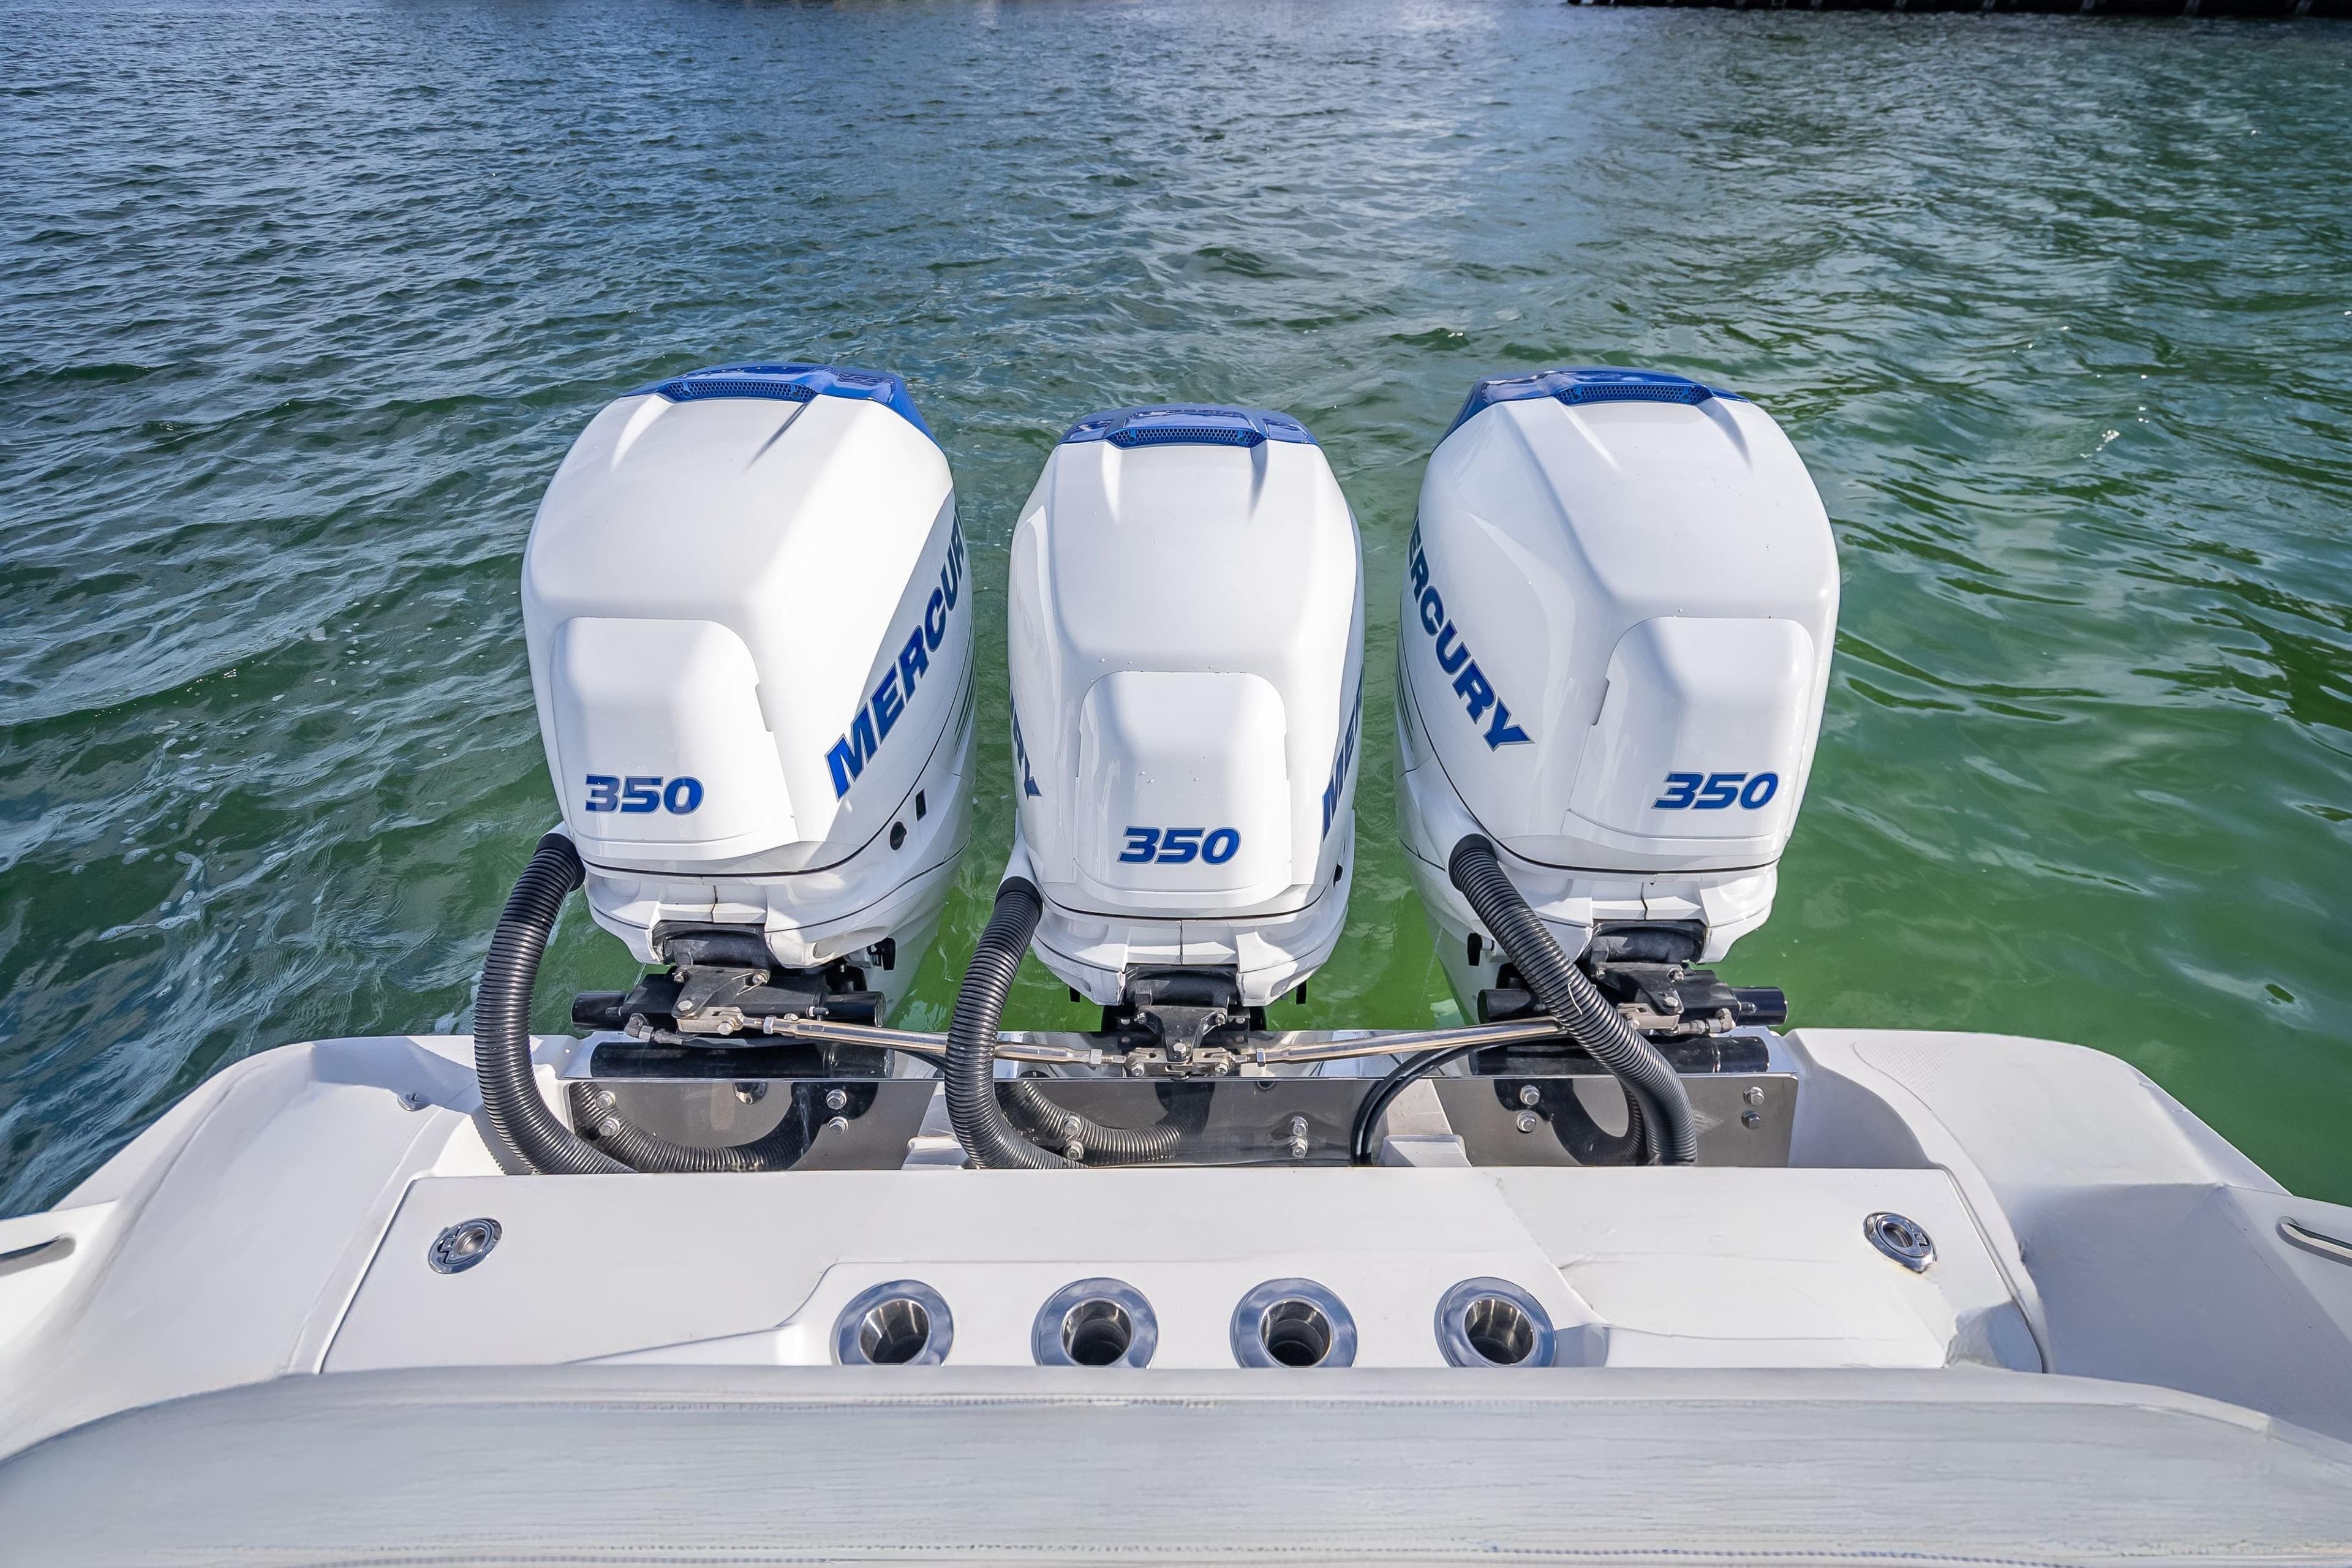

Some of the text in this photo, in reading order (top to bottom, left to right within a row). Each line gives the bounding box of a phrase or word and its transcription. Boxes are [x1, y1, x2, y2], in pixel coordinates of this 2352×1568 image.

[1409, 507, 1536, 752] ERCURY
[824, 500, 965, 802] MERCUR
[585, 774, 704, 815] 350
[1651, 771, 1779, 810] 350
[1117, 826, 1242, 865] 350
